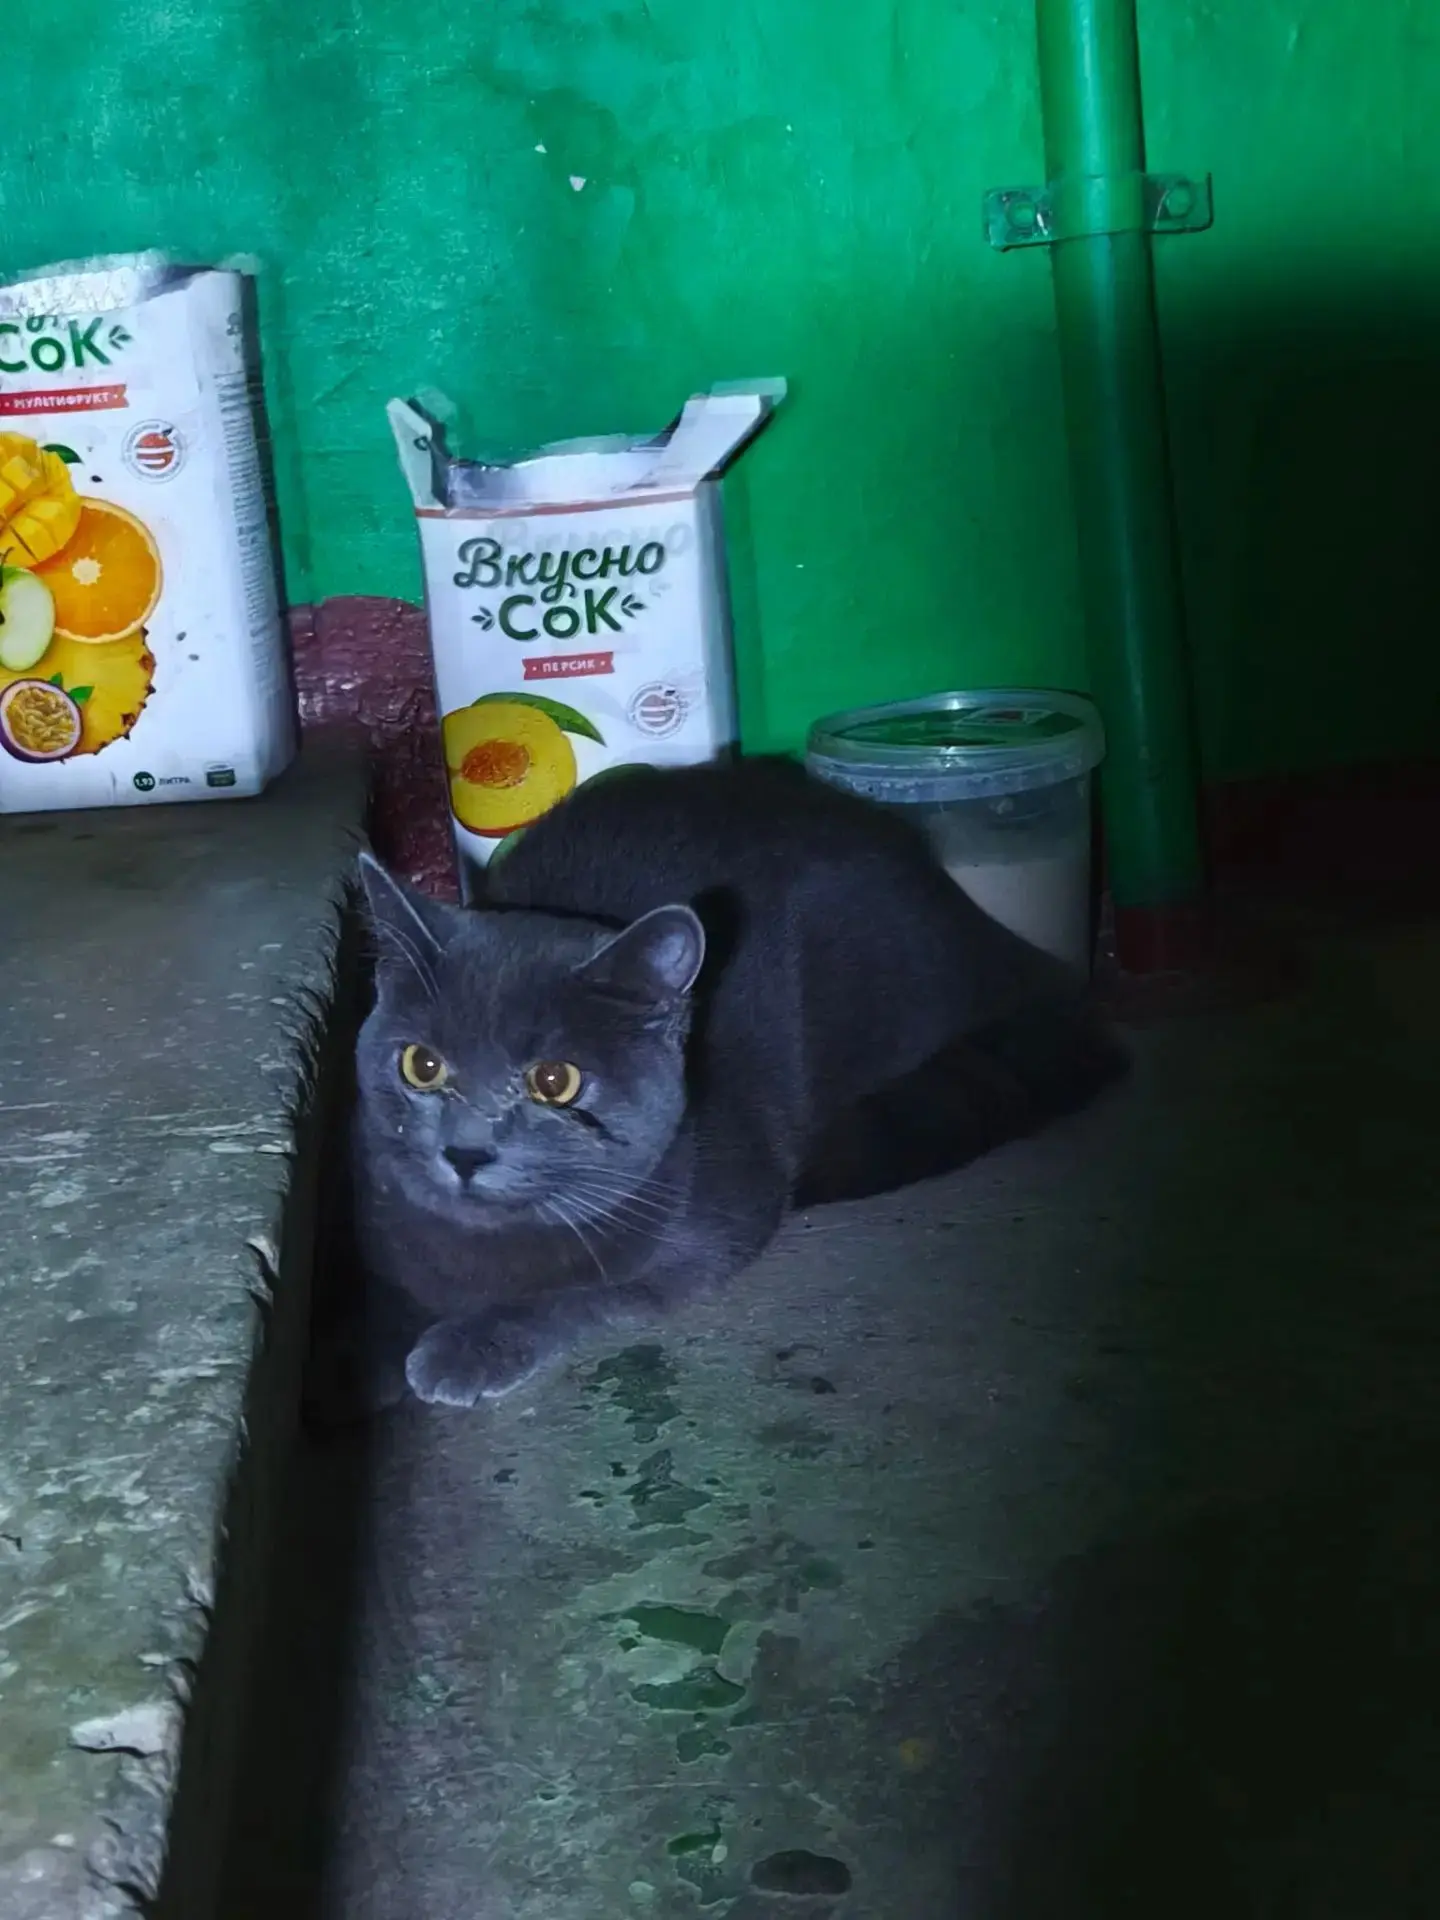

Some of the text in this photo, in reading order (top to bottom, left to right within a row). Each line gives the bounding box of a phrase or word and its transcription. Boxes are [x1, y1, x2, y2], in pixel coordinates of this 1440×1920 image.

[14, 392, 110, 409] МУЛЬТИФРУКТ
[453, 537, 664, 603] Вкусно
[542, 659, 596, 673] ПЕРСИК
